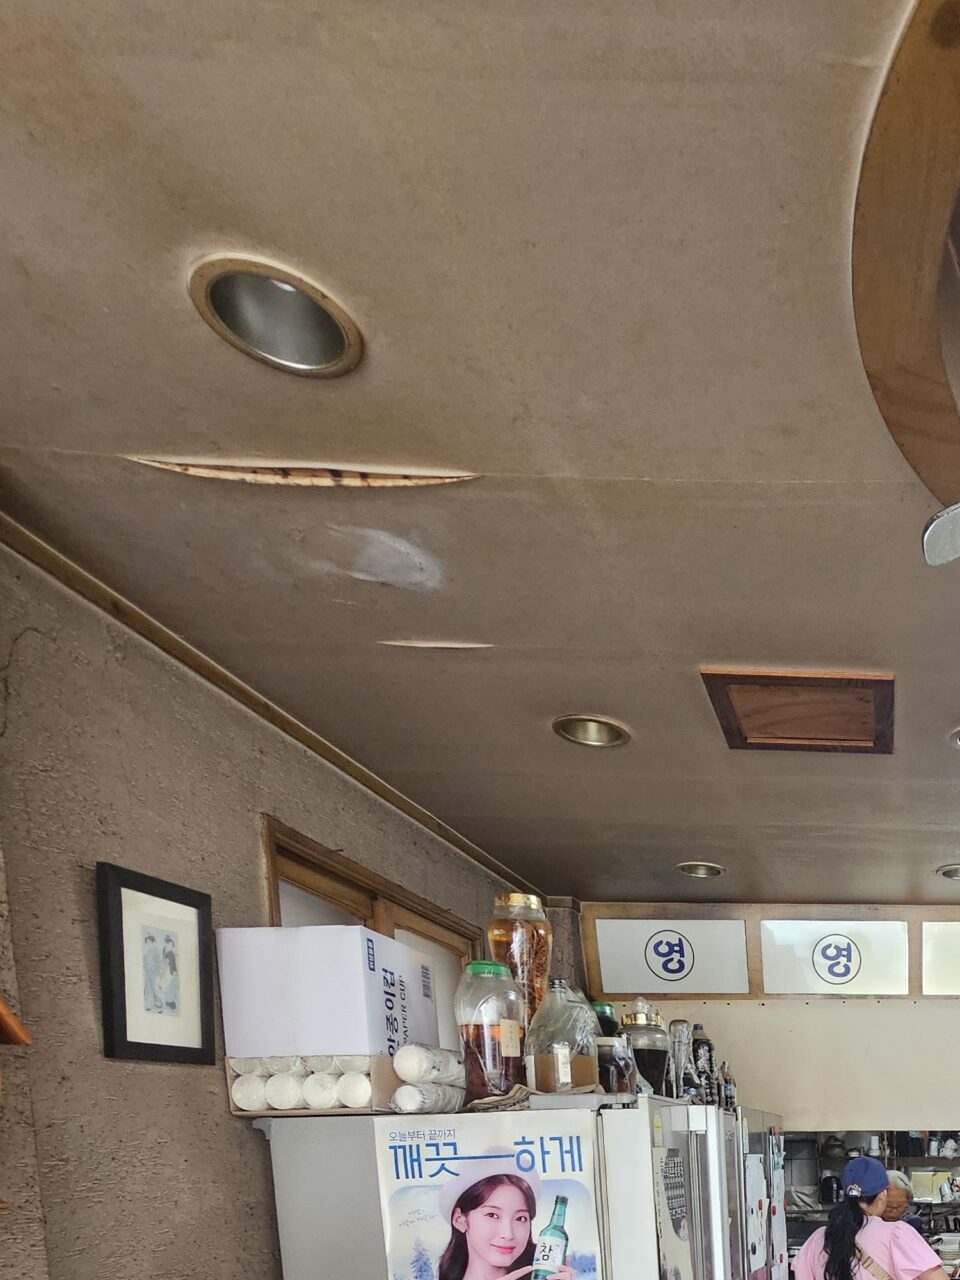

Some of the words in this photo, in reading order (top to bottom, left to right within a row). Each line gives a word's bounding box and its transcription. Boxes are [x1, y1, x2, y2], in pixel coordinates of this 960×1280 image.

[388, 1130, 426, 1142] 오늘부터
[427, 1128, 457, 1141] 끝까지
[540, 1242, 554, 1261] 참
